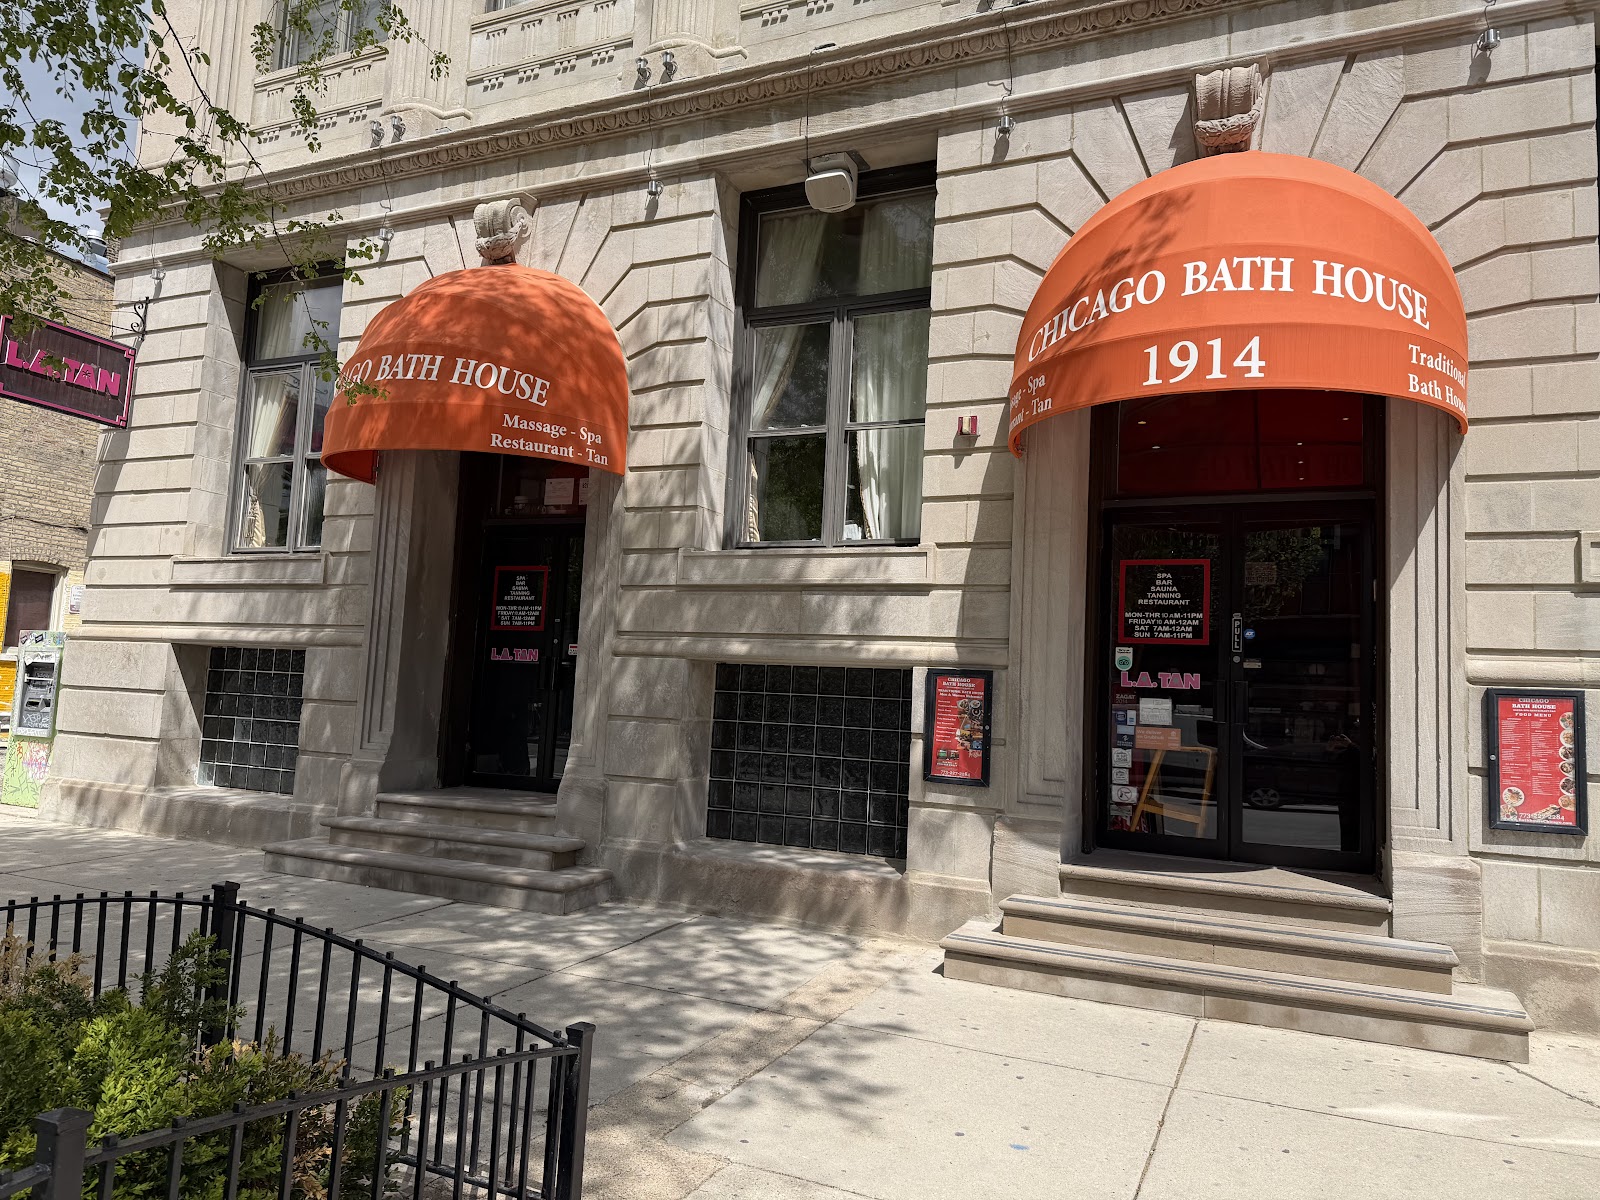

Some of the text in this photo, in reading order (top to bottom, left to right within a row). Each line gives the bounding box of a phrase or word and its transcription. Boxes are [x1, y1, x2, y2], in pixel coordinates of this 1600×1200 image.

[1028, 256, 1430, 363] CHICAGO BATH HOUSE
[62, 357, 120, 396] TAN
[1142, 335, 1266, 386] 1914
[1408, 344, 1466, 390] Traditional
[375, 353, 444, 382] BATH
[449, 357, 550, 407] HOUSE
[1027, 374, 1046, 396] Spa
[1408, 373, 1442, 400] Bath
[1032, 397, 1053, 416] Tan
[502, 413, 567, 438] Massage
[579, 427, 602, 446] Spa
[490, 433, 574, 459] Restaurant
[586, 448, 609, 466] Tan
[490, 647, 539, 661] L.A. TAN
[1121, 671, 1200, 689] L.A. TAN
